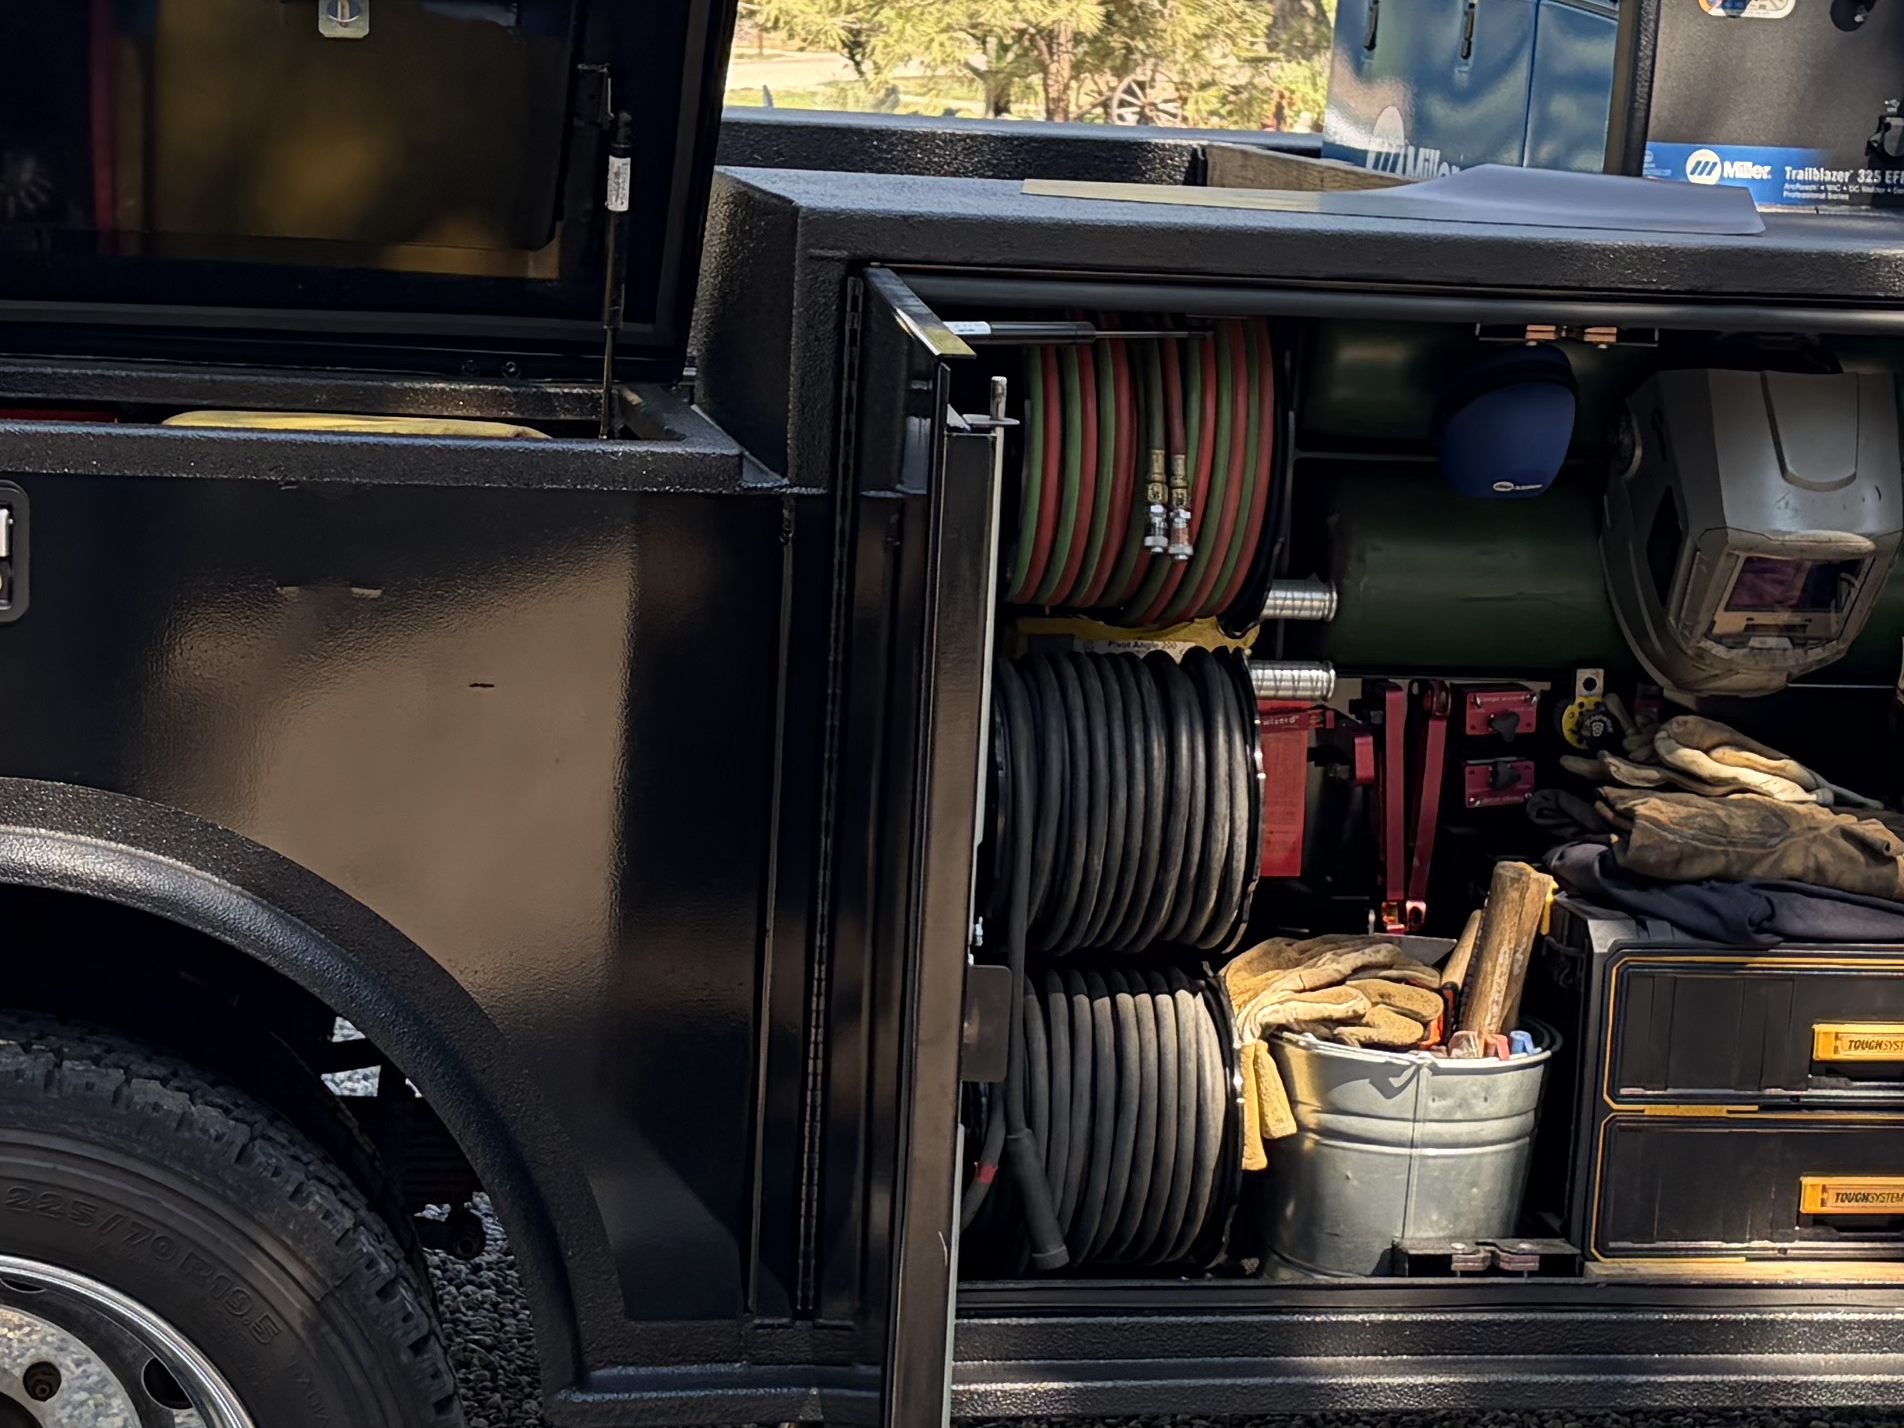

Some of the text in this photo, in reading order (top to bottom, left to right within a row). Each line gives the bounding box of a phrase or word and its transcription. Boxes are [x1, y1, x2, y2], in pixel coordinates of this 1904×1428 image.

[1723, 160, 1771, 180] Miller
[1784, 166, 1904, 184] Trailblazer 325 EFI
